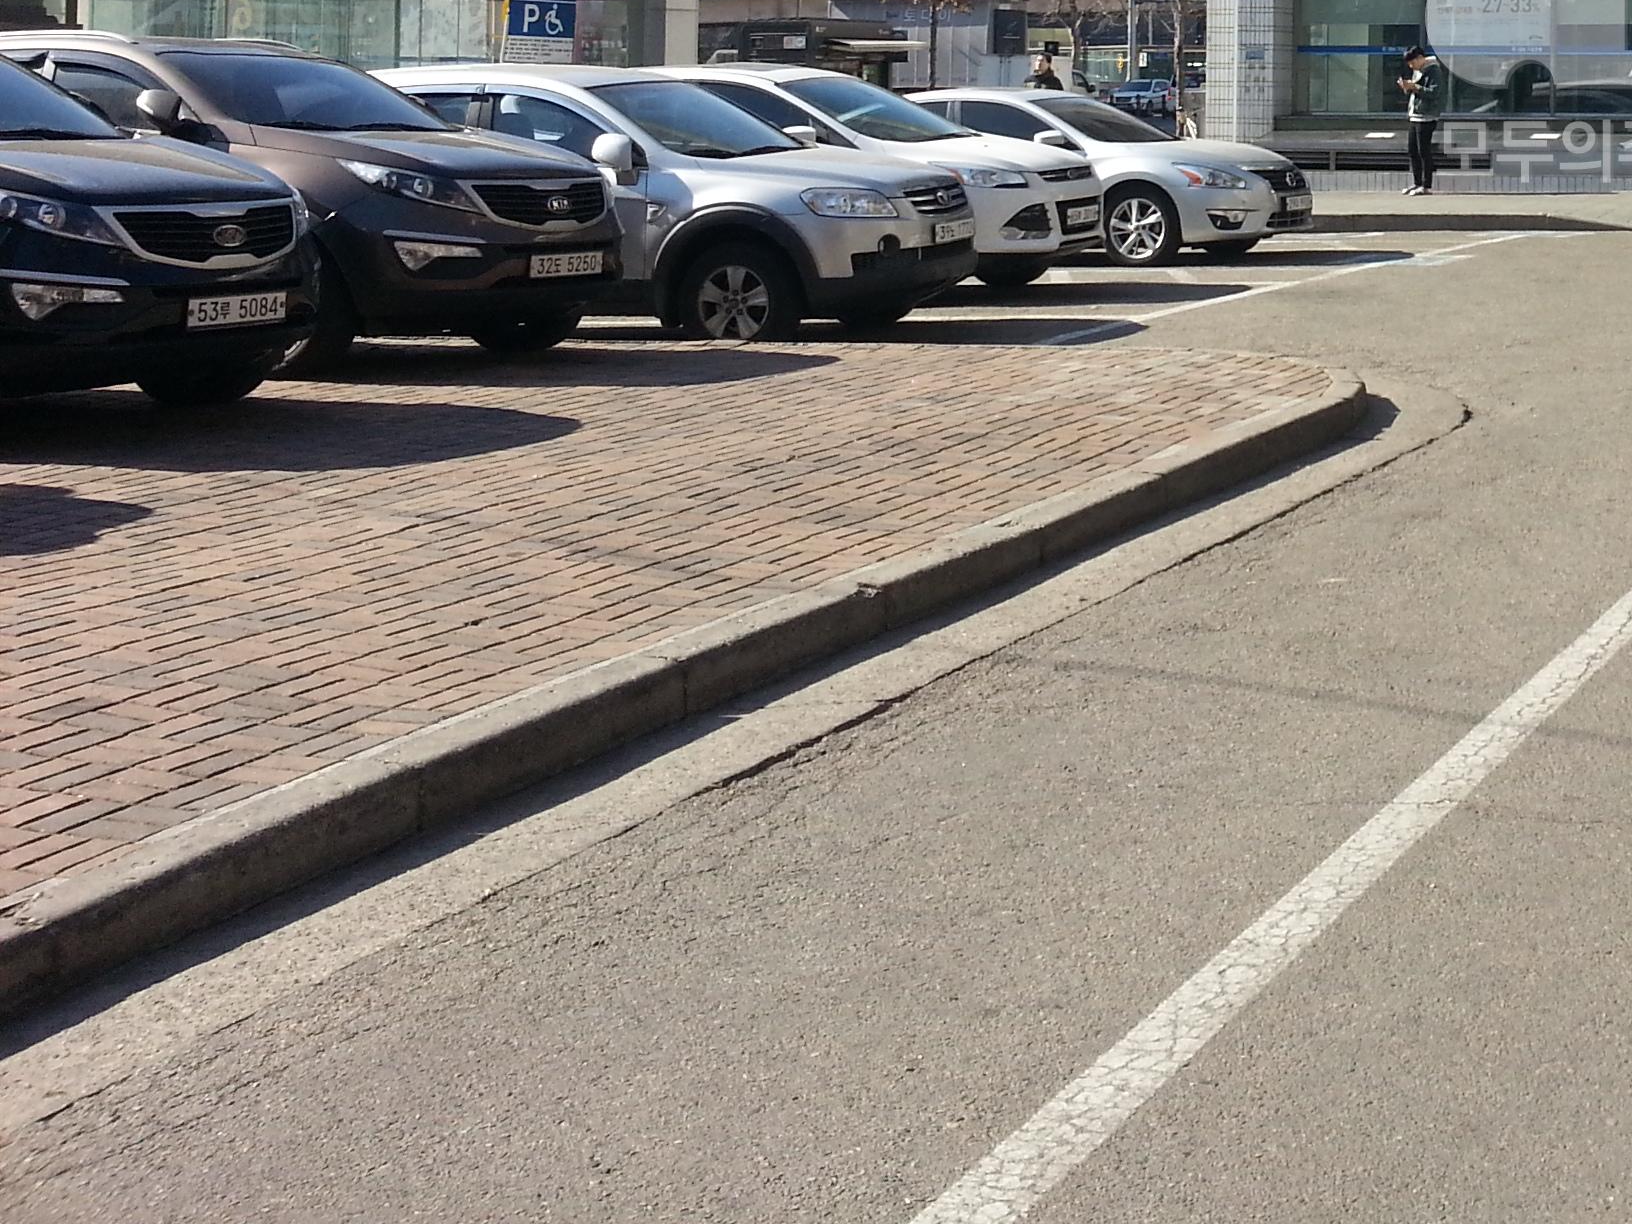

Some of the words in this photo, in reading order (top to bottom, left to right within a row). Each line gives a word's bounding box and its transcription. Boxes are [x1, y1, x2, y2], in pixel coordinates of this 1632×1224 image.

[522, 3, 541, 33] P
[197, 301, 231, 322] 53루
[239, 296, 278, 319] 5084
